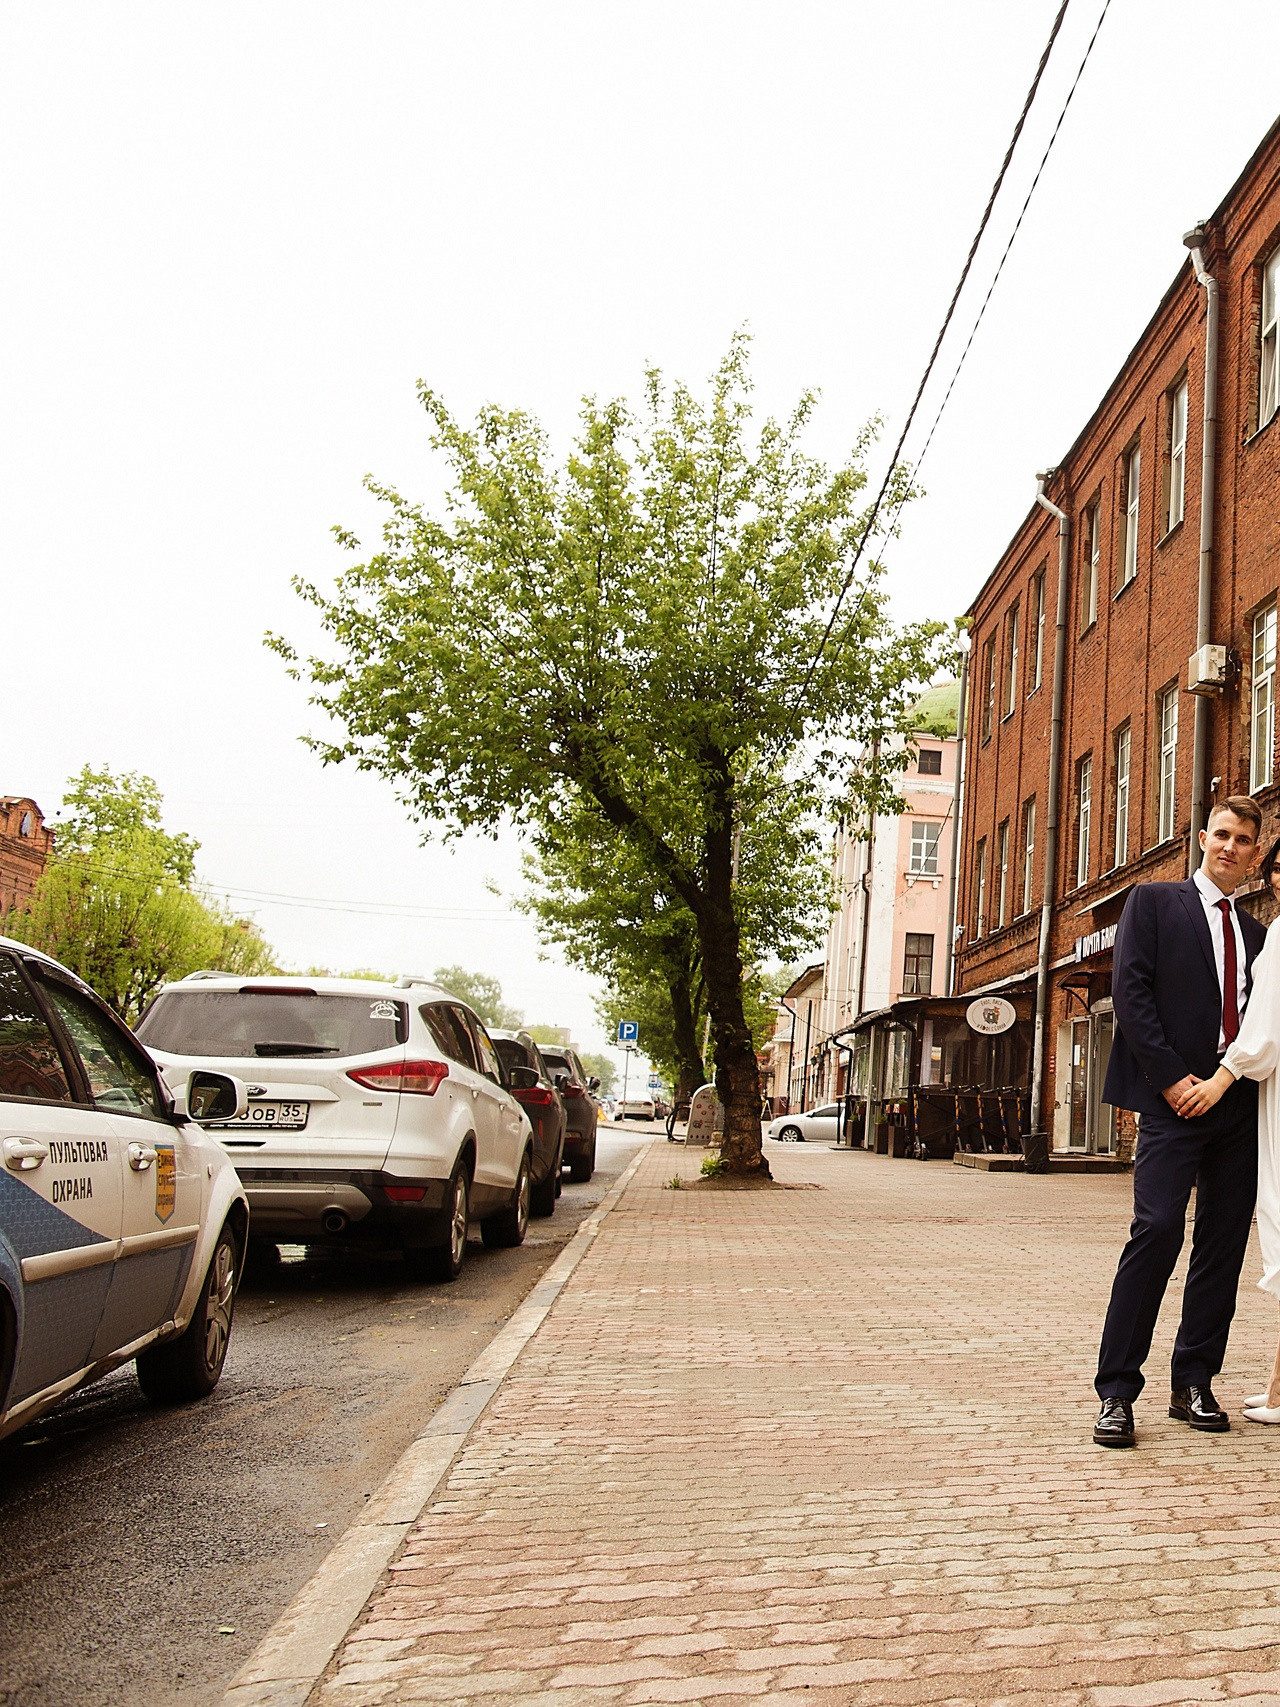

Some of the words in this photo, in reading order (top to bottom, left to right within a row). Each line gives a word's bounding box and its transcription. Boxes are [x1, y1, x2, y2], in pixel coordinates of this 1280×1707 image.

[623, 1023, 635, 1039] P
[282, 1104, 301, 1117] 35
[49, 1141, 108, 1164] ПУЛЬТОВАЯ
[52, 1177, 93, 1204] ОХРАНА
